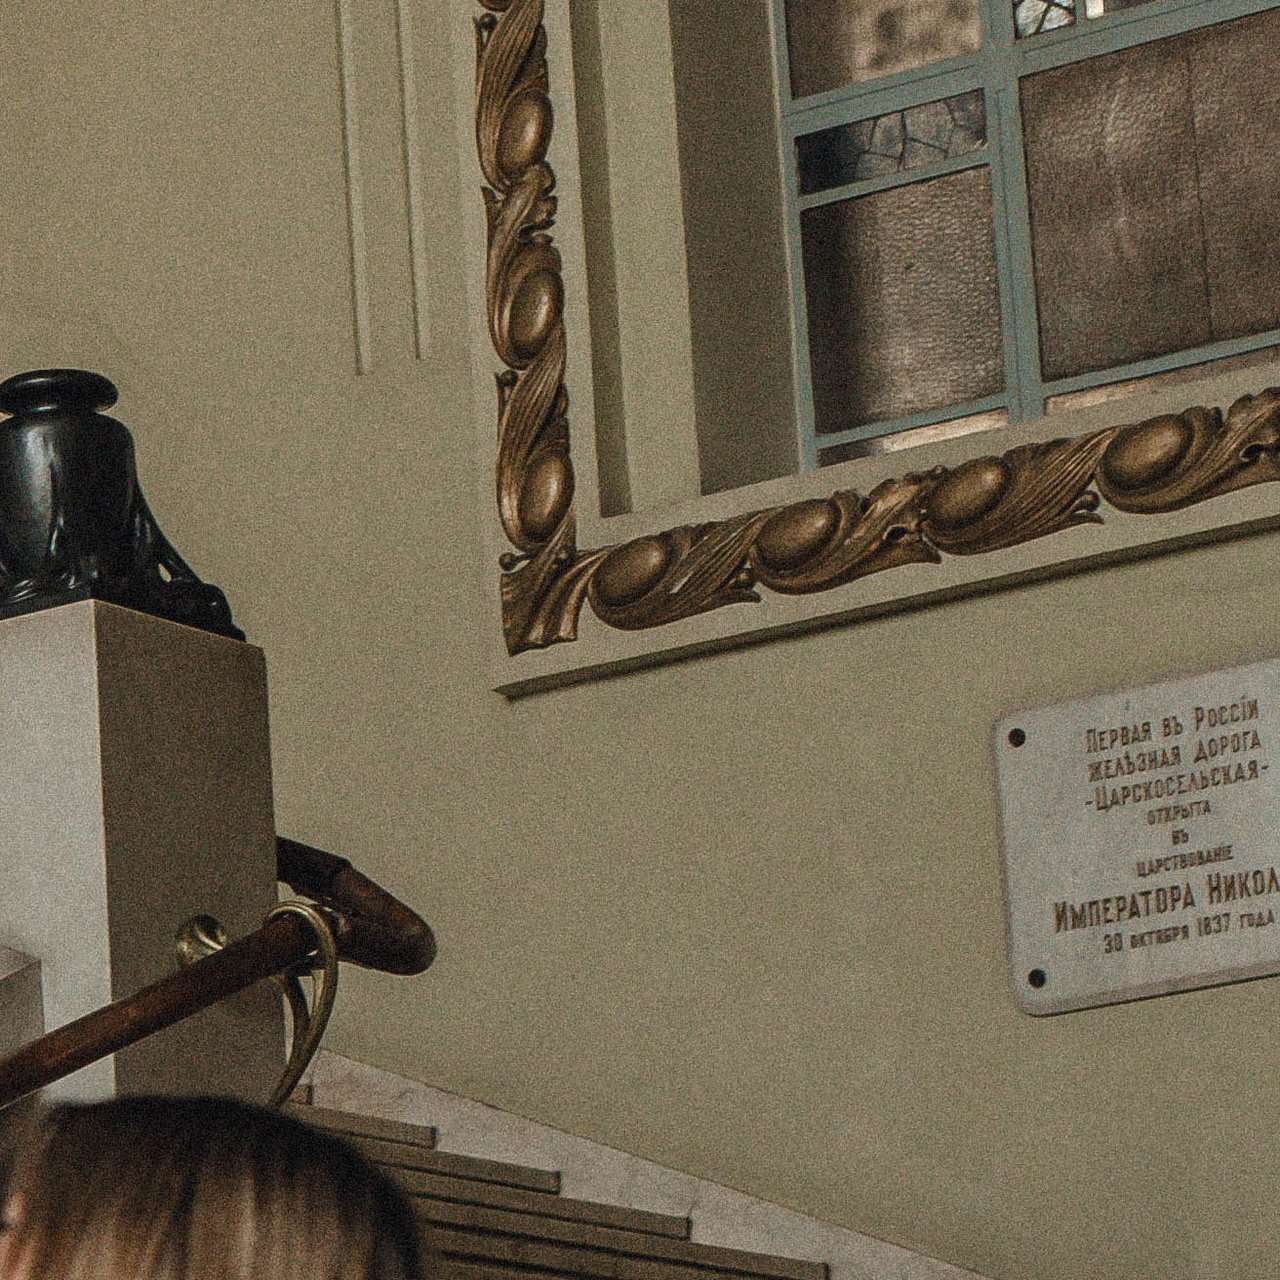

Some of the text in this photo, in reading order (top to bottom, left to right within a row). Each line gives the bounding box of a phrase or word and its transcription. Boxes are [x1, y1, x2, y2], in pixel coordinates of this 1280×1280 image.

[1086, 722, 1152, 753] ПЕРВАЯ
[1162, 716, 1183, 737] ВЪ
[1194, 730, 1261, 763] ДОРОГА
[1054, 882, 1195, 933] ИМПЕРАТОРА
[1104, 932, 1123, 953] 30
[1196, 912, 1231, 936] 1837
